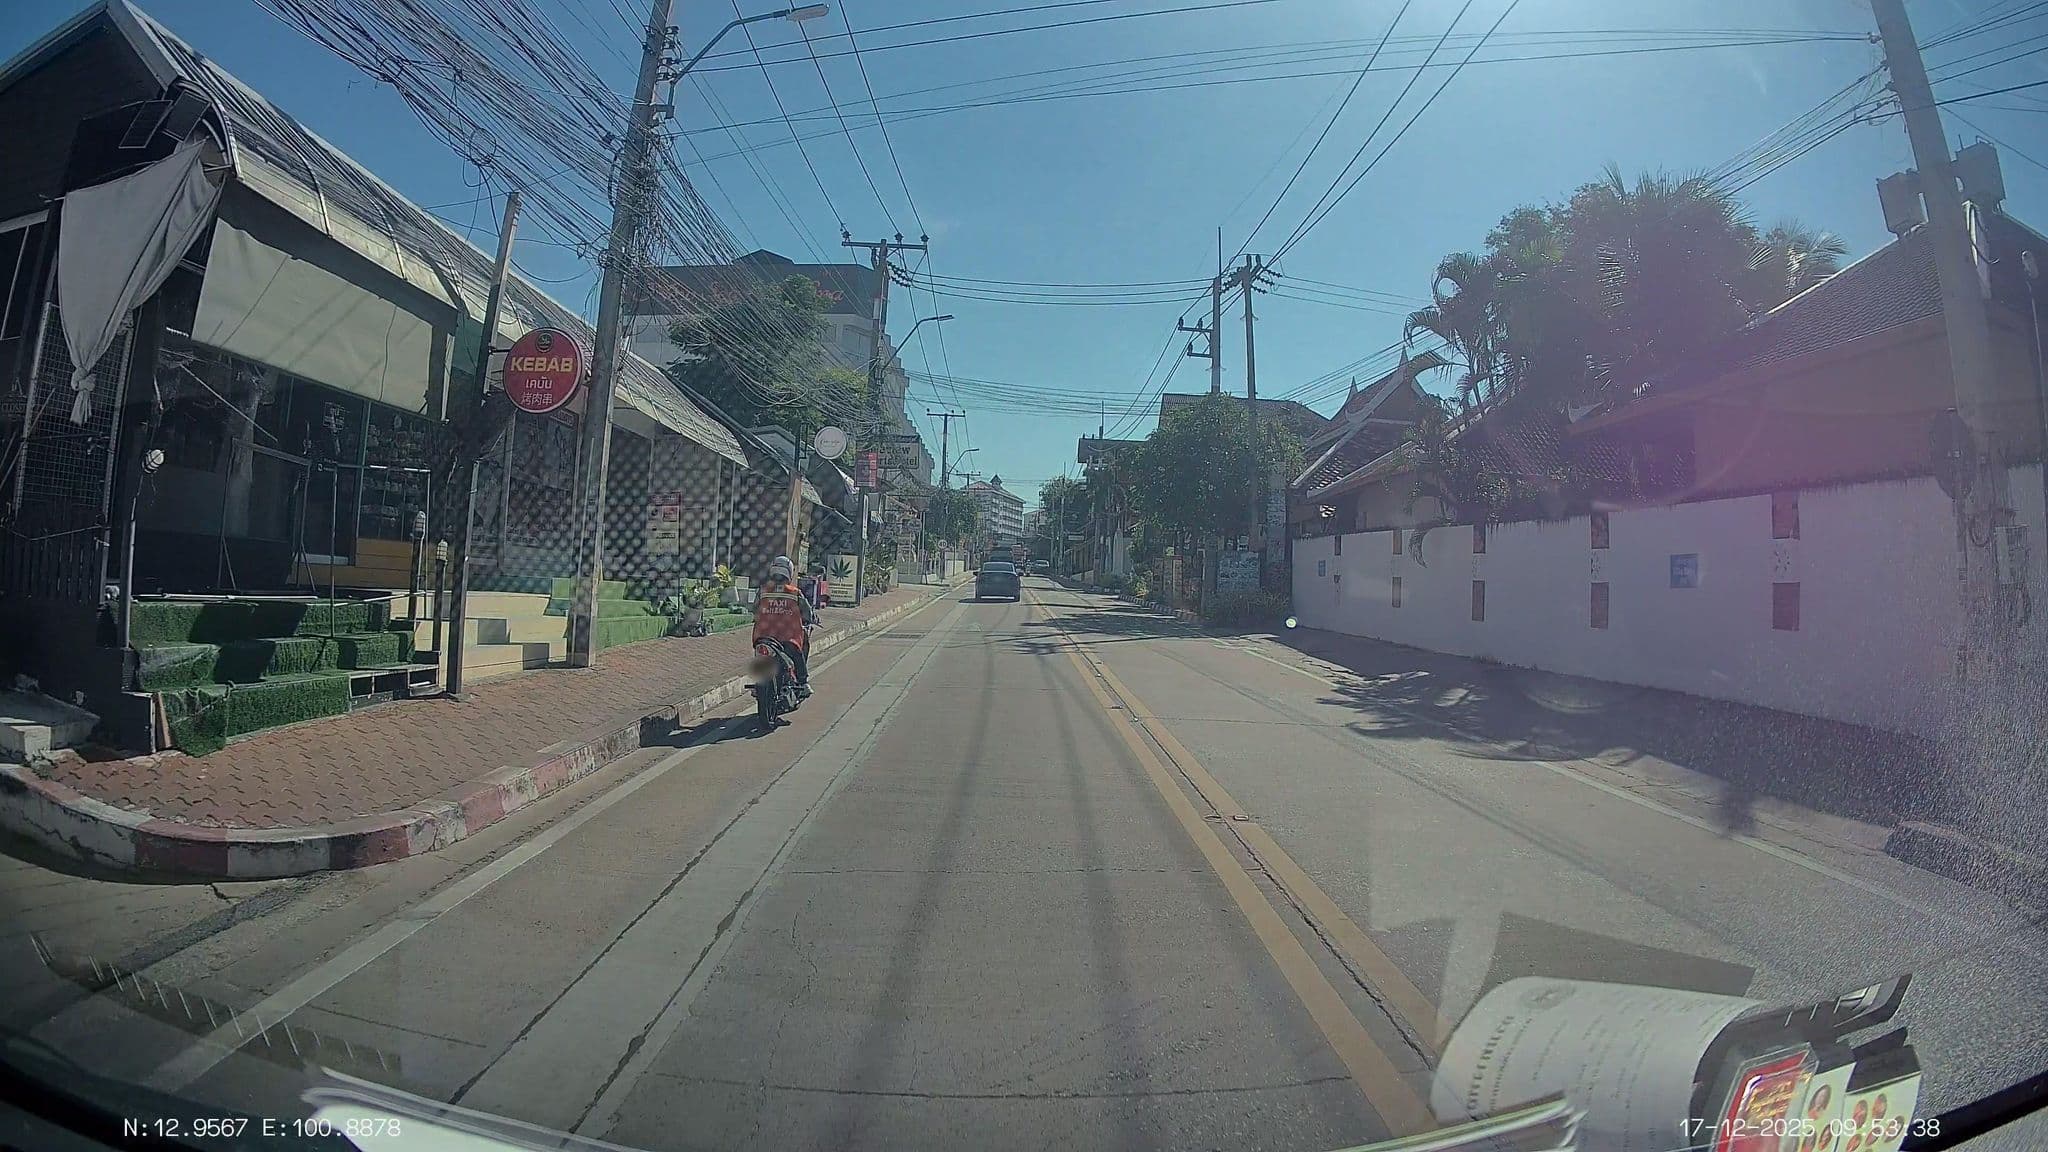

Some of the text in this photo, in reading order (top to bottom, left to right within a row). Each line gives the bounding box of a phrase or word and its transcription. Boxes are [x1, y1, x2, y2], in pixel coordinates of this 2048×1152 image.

[511, 356, 574, 372] KEBAB
[521, 391, 553, 406] 烤肉串
